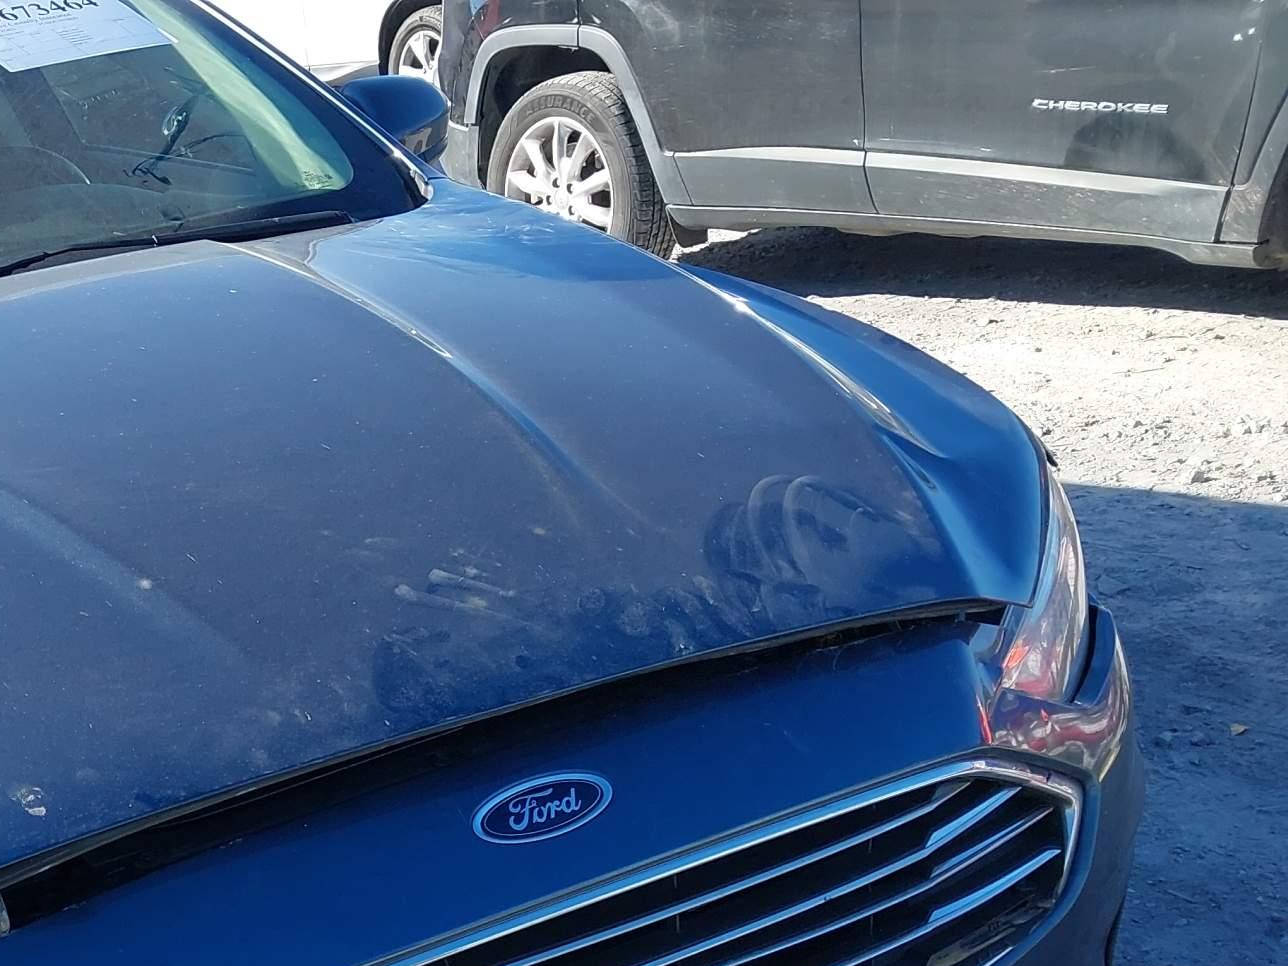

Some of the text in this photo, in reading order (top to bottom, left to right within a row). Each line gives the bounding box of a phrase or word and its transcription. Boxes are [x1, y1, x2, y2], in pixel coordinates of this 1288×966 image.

[527, 95, 596, 123] ASSURANCE
[1031, 98, 1169, 114] CHEROKEE
[509, 788, 581, 830] Ford
